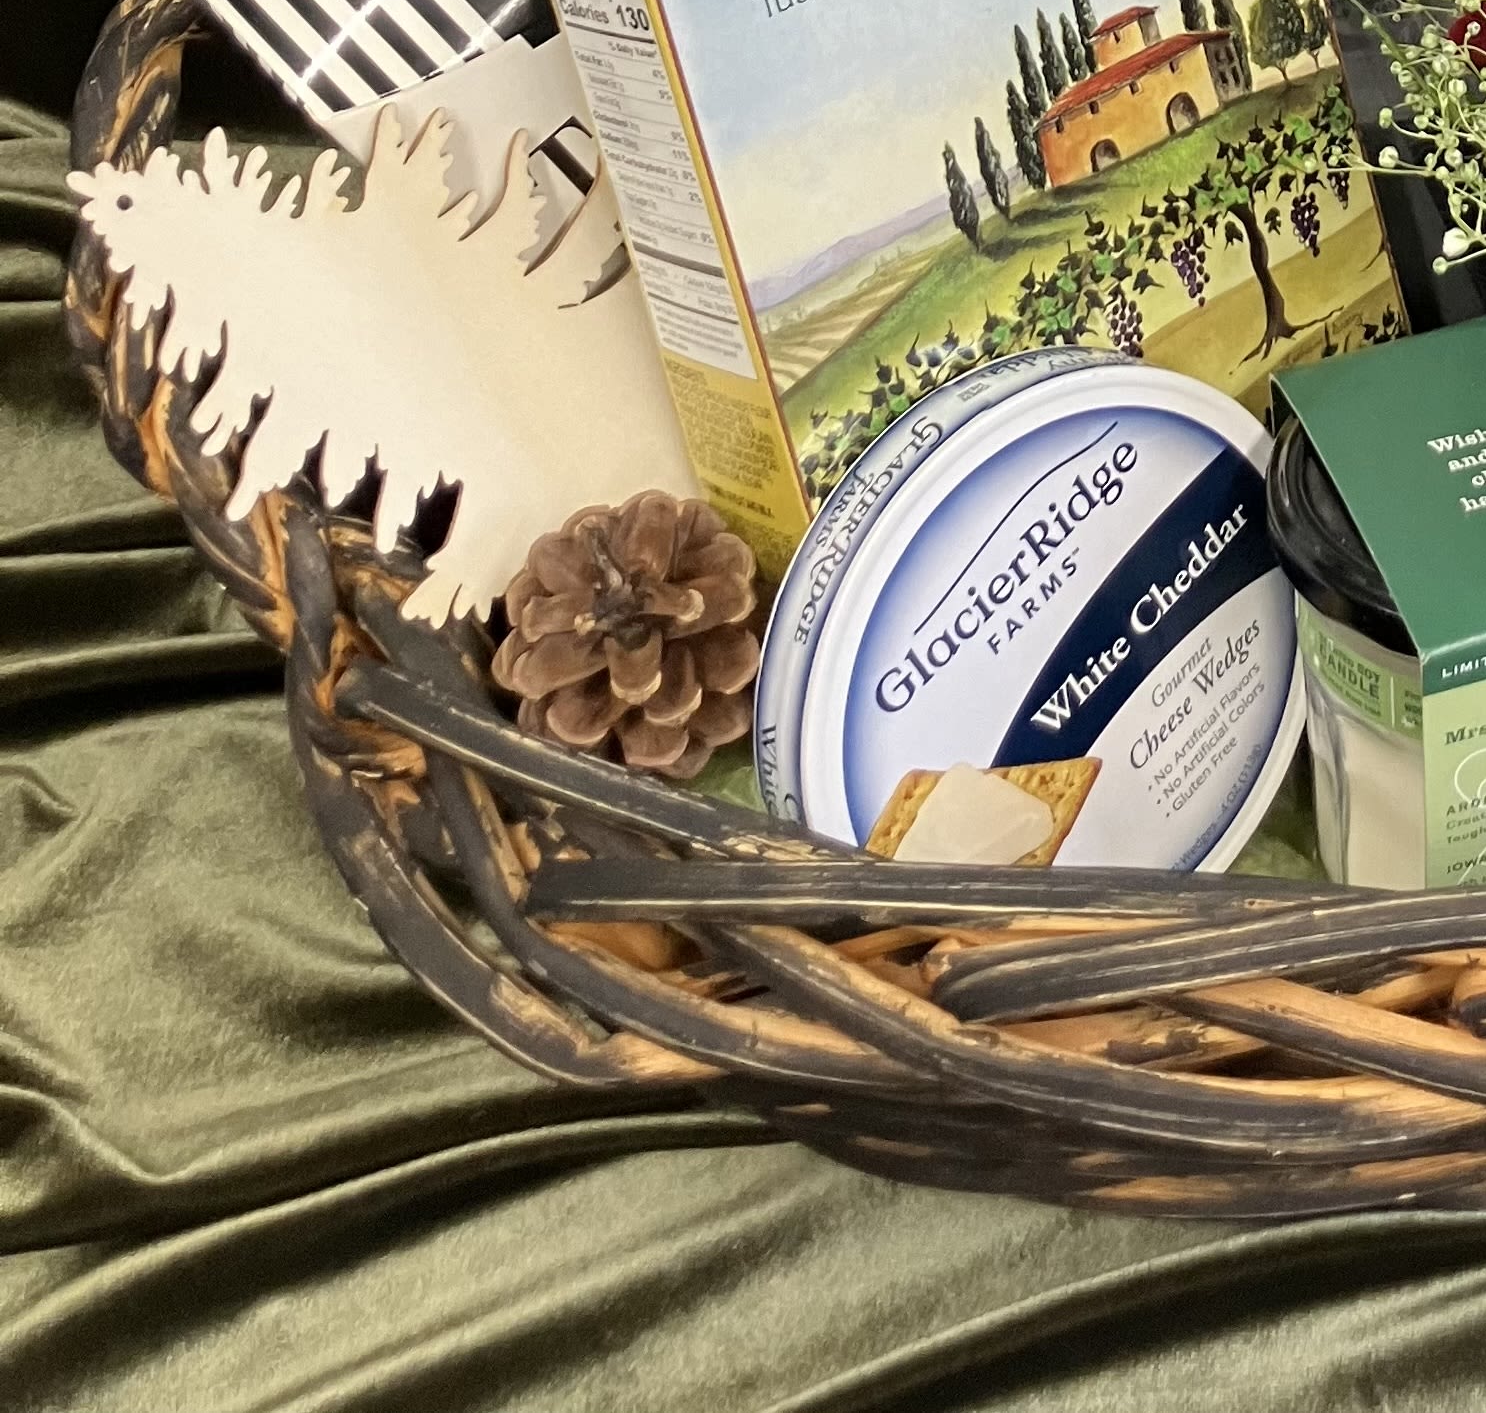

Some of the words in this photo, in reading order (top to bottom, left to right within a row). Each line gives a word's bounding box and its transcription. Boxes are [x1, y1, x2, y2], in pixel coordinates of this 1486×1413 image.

[616, 4, 650, 31] 130
[875, 442, 1137, 713] GlacierRidge
[1031, 637, 1132, 731] White
[1130, 504, 1249, 635] Cheddar
[1129, 695, 1193, 770] Cheese
[1193, 619, 1261, 696] Wedges
[1151, 637, 1213, 708] Gourmet
[1153, 766, 1173, 786] No
[1175, 707, 1219, 763] Artificial
[1220, 662, 1261, 710] Flavors
[1163, 778, 1182, 799] No
[1184, 722, 1229, 776] Artificial
[1229, 681, 1266, 724] Colors
[1172, 767, 1211, 812] Gluten
[1213, 737, 1238, 768] Free
[1447, 826, 1486, 844] Tough
